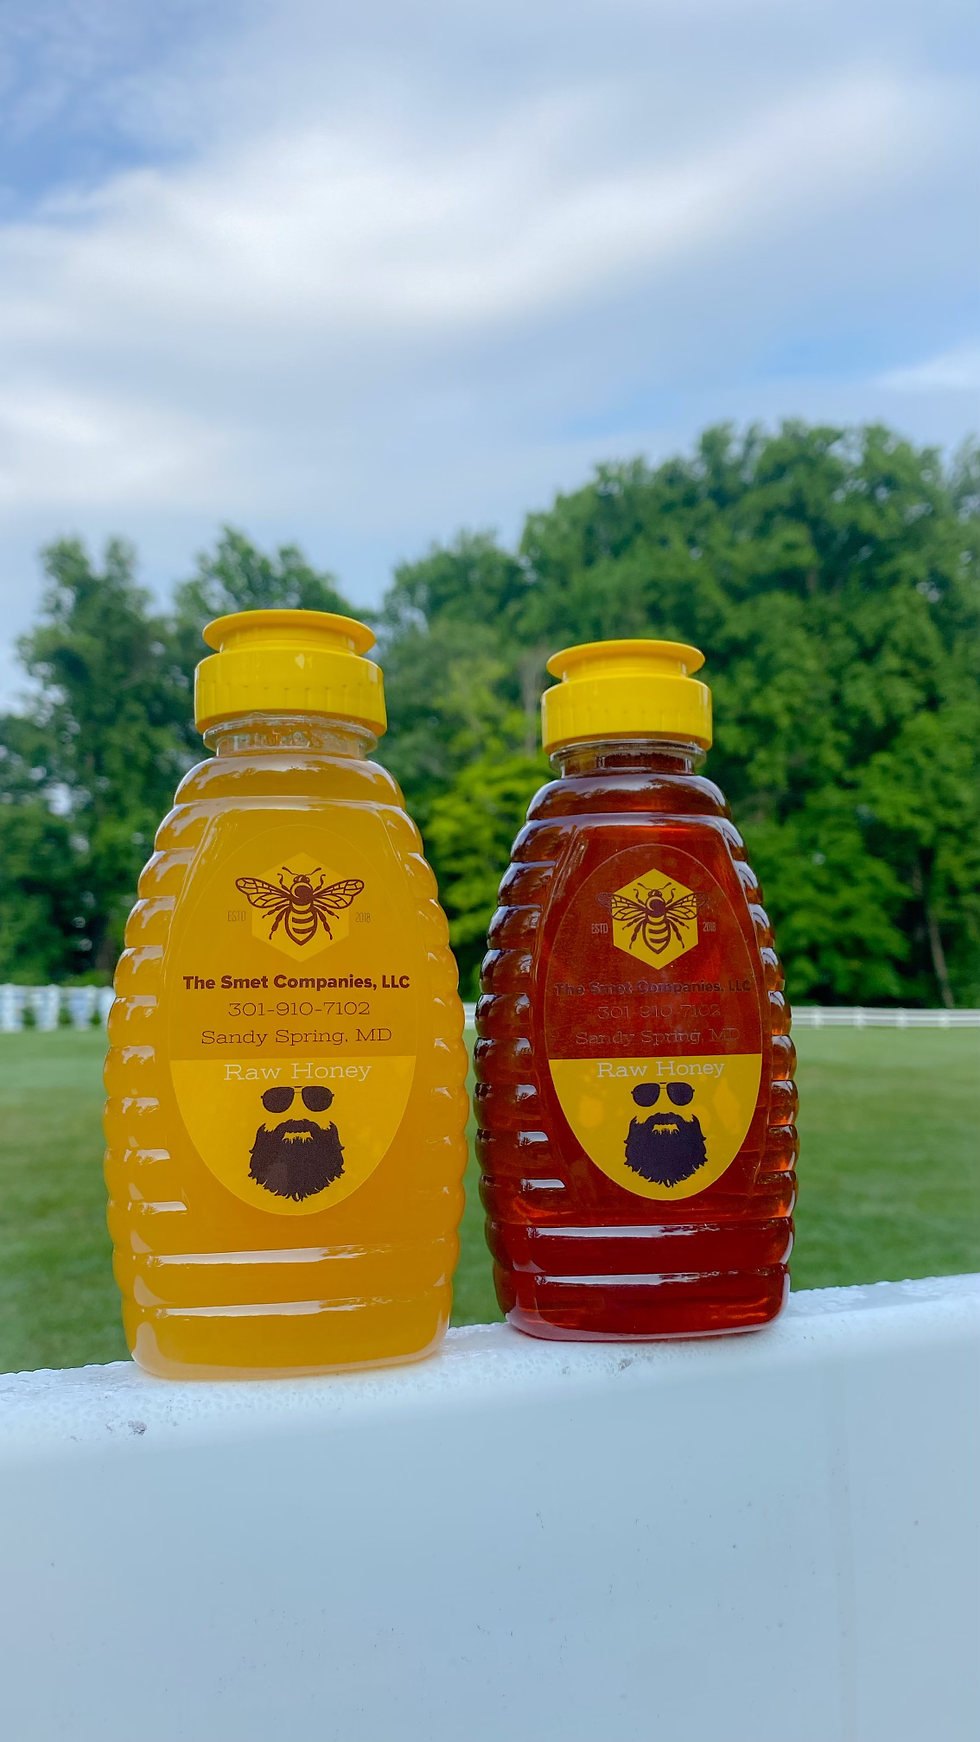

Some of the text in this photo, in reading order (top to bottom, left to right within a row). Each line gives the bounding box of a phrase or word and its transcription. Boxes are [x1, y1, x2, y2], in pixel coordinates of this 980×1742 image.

[355, 911, 371, 923] 2018
[591, 922, 609, 934] ESTD
[183, 973, 411, 991] The Smet Companies, LLC
[555, 979, 751, 996] The Smet Companies, LLC
[228, 1001, 371, 1017] 301-910-7102
[597, 1004, 721, 1020] 301-910-7102
[201, 1030, 268, 1047] Sandy
[355, 1027, 393, 1042] MD
[575, 1031, 634, 1046] Sandy
[709, 1027, 741, 1042] MD
[223, 1062, 373, 1082] Raw Honey
[596, 1060, 726, 1078] Raw Honey
